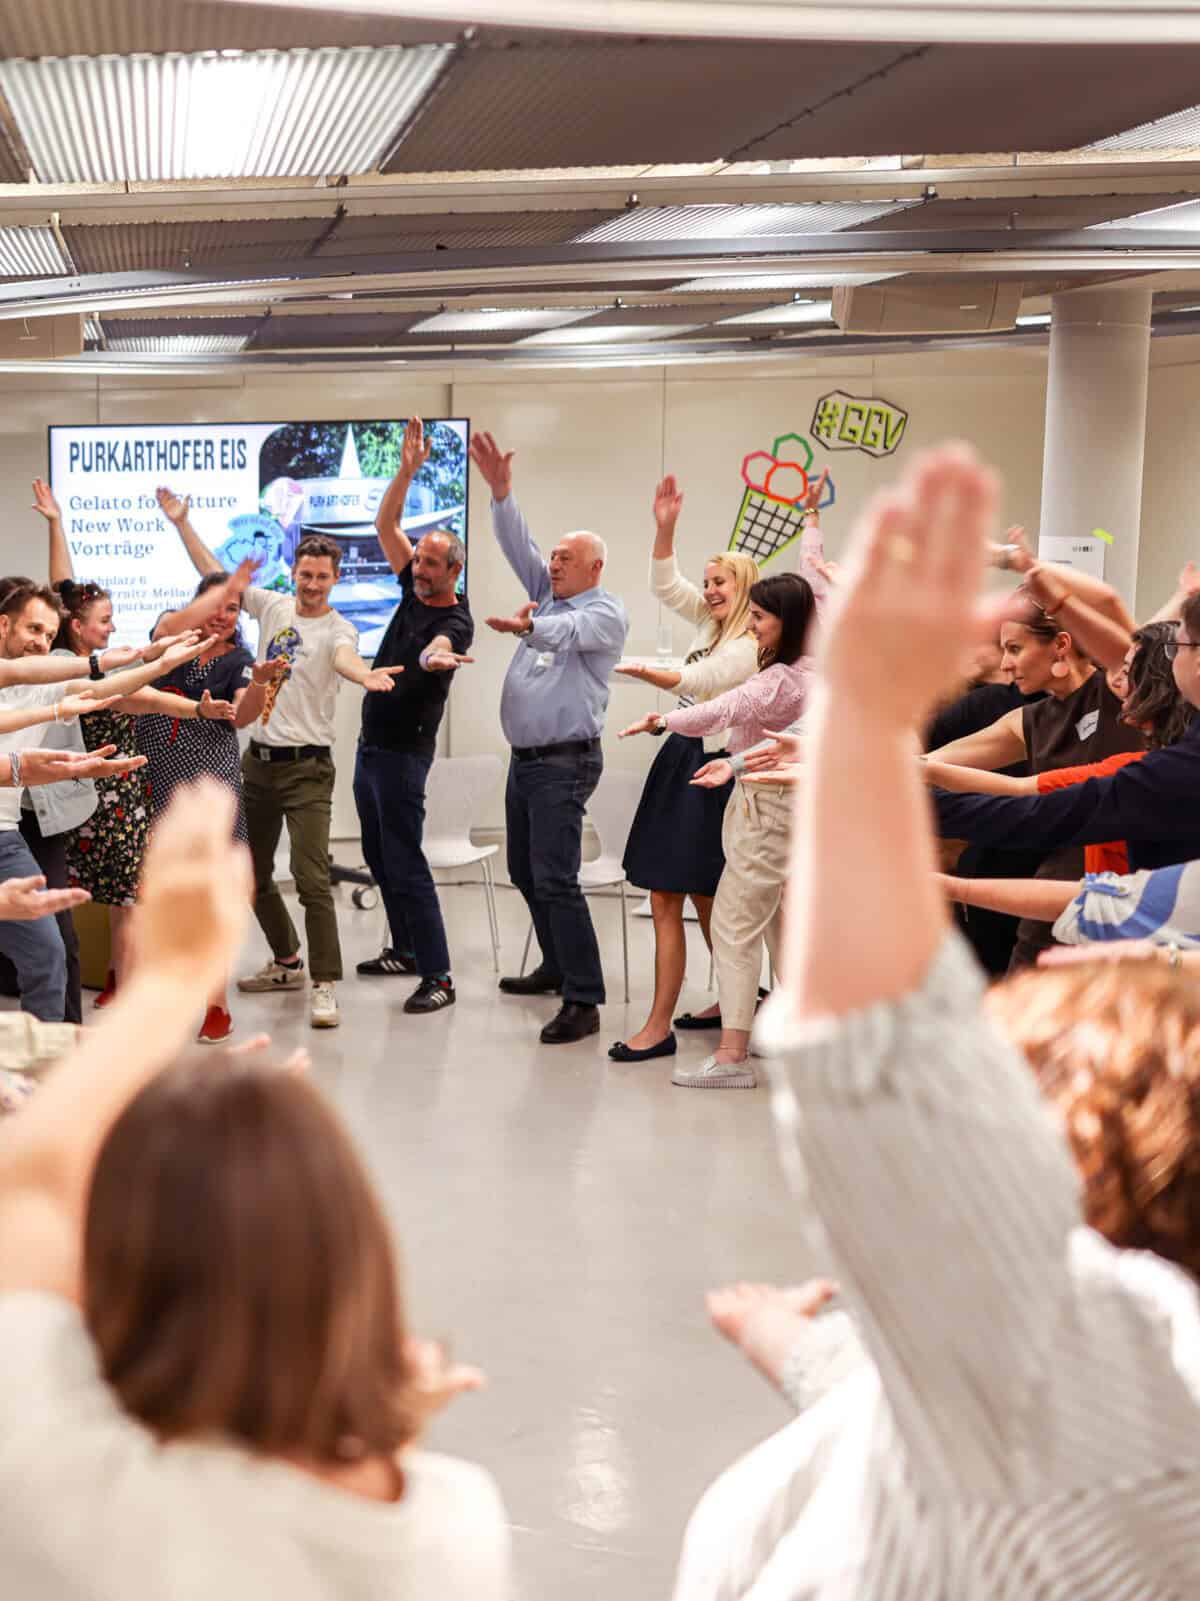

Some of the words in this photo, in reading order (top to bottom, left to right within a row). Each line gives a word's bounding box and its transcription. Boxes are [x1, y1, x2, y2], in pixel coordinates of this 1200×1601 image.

[816, 400, 906, 450] #GGV
[69, 439, 214, 472] PURKARTHOFER
[221, 439, 247, 470] EIS
[69, 495, 132, 511] Gelato
[138, 494, 162, 510] fo
[71, 519, 112, 533] New
[117, 517, 165, 532] Work
[71, 540, 155, 558] Vorträge
